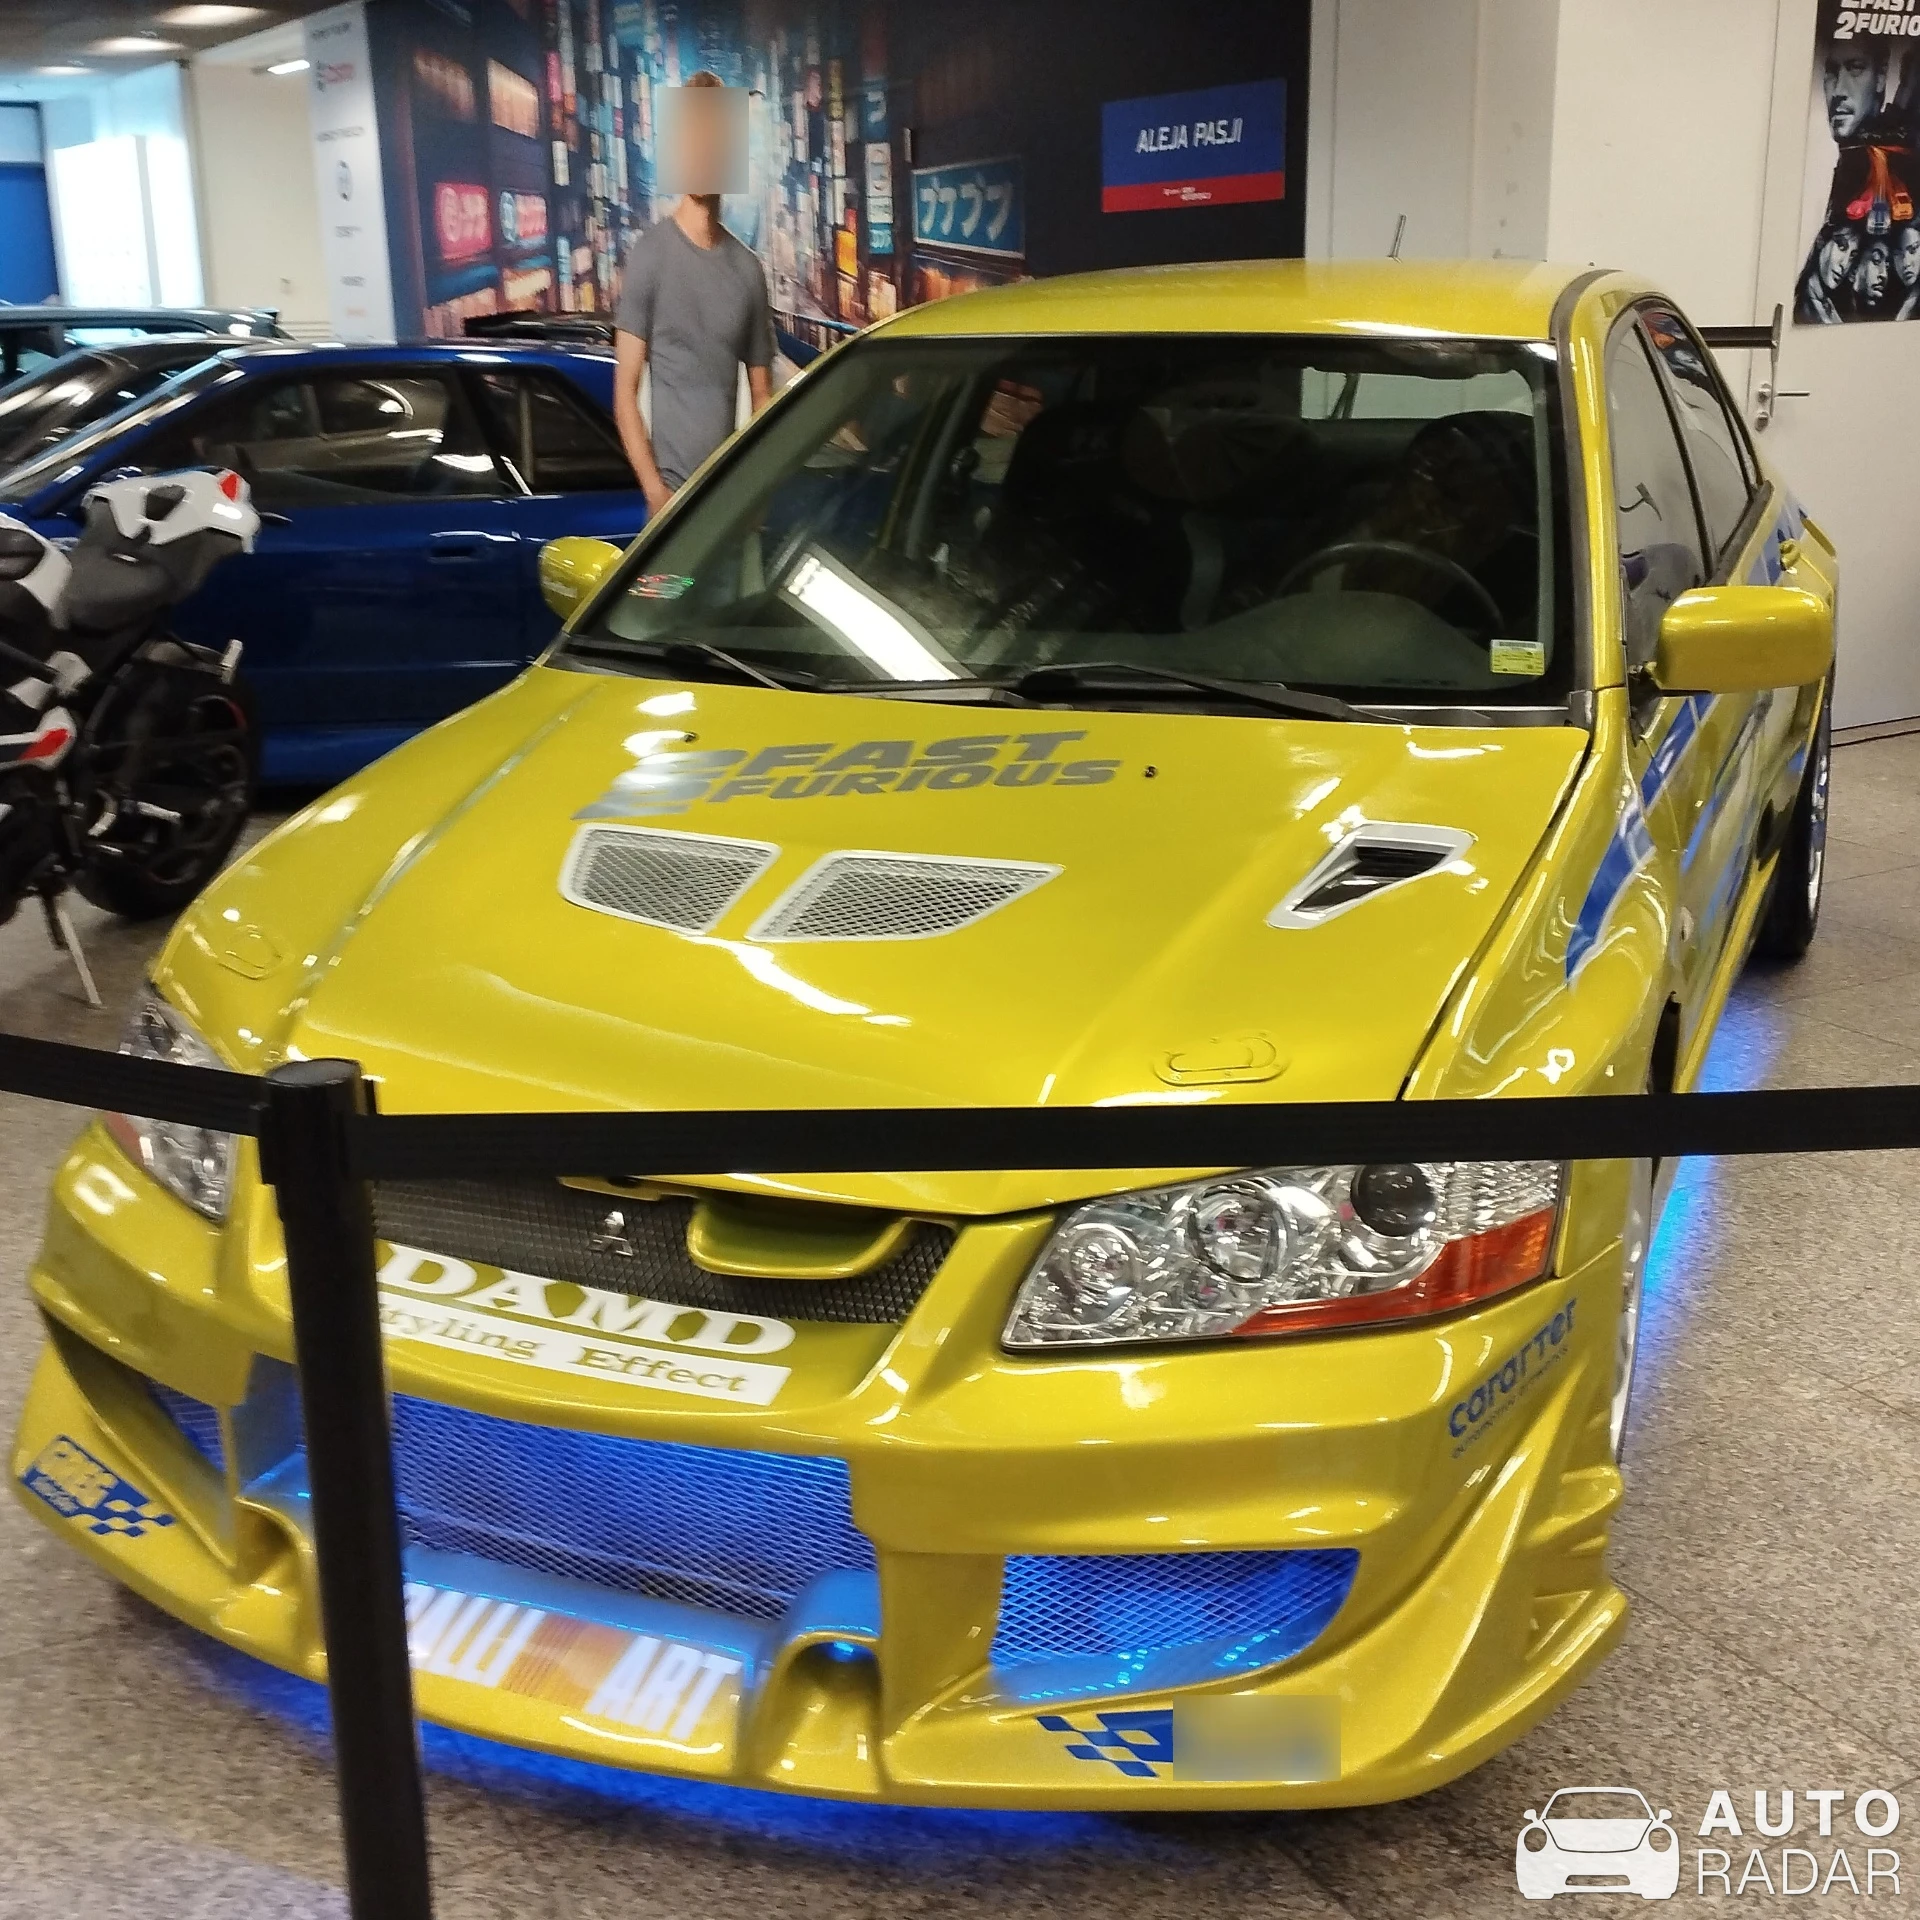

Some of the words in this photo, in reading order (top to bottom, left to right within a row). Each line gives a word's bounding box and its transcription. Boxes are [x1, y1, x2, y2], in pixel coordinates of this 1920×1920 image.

[1134, 124, 1188, 153] ALEJA
[1193, 117, 1243, 148] PASJI
[377, 1243, 796, 1354] DAMD
[379, 1302, 546, 1360] tyling
[566, 1346, 748, 1392] Effect
[582, 1634, 743, 1741] ART
